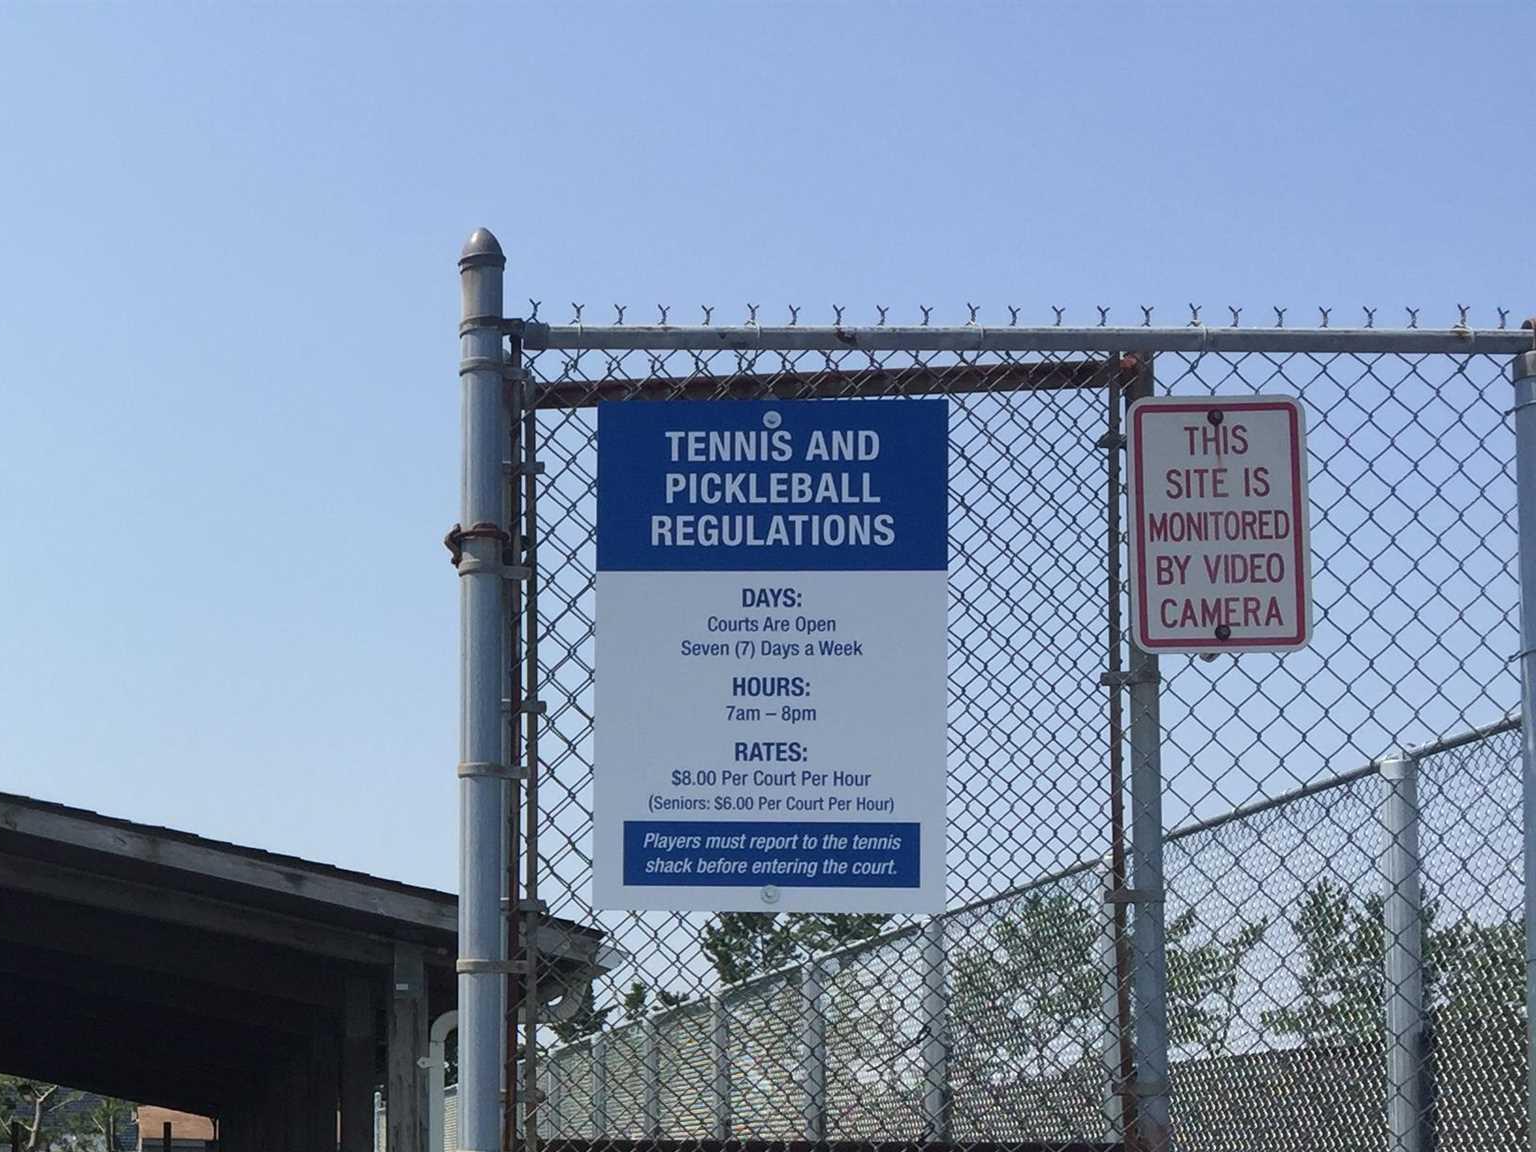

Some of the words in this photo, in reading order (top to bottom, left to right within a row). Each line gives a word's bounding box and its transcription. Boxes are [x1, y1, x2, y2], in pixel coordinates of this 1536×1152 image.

[665, 430, 792, 462] TENNIS
[806, 430, 880, 461] AND
[1184, 424, 1249, 456] THIS
[665, 473, 880, 503] PICKLEBALL
[1165, 468, 1228, 499] SITE
[1244, 467, 1270, 497] IS
[651, 515, 895, 546] REGULATIONS
[1149, 510, 1290, 543] MONITORED
[1156, 554, 1192, 585] BY
[1203, 552, 1284, 584] VIDEO
[742, 588, 803, 607] DAYS:
[1160, 597, 1284, 629] CAMERA
[708, 616, 759, 632] Courts
[763, 616, 789, 631] Are
[795, 617, 836, 635] Open
[681, 641, 729, 656] Seven
[735, 640, 756, 658] (7)
[761, 641, 800, 658] Days
[805, 645, 814, 655] a
[819, 641, 863, 656] Week
[732, 677, 811, 697] HOURS:
[726, 706, 760, 721] 7am
[782, 706, 816, 724] 8pm
[735, 743, 807, 762] RATES:
[672, 770, 716, 786] $8.00
[722, 770, 748, 786] Per
[753, 771, 796, 786] Court
[801, 771, 828, 786] Per
[833, 772, 871, 786] Hour
[649, 795, 710, 813] (Seniors:
[714, 796, 754, 810] $6.00
[759, 797, 781, 811] Per
[786, 797, 824, 811] Court
[828, 797, 852, 811] Per
[857, 797, 894, 814] Hour)
[643, 833, 701, 852] Players
[705, 833, 745, 849] must
[750, 834, 797, 852] report
[802, 835, 817, 849] to
[823, 833, 847, 849] the
[852, 834, 902, 850] tennis
[645, 858, 692, 873] shack
[697, 858, 747, 874] before
[752, 860, 817, 877] entering
[823, 858, 847, 874] the
[852, 859, 898, 875] court.
